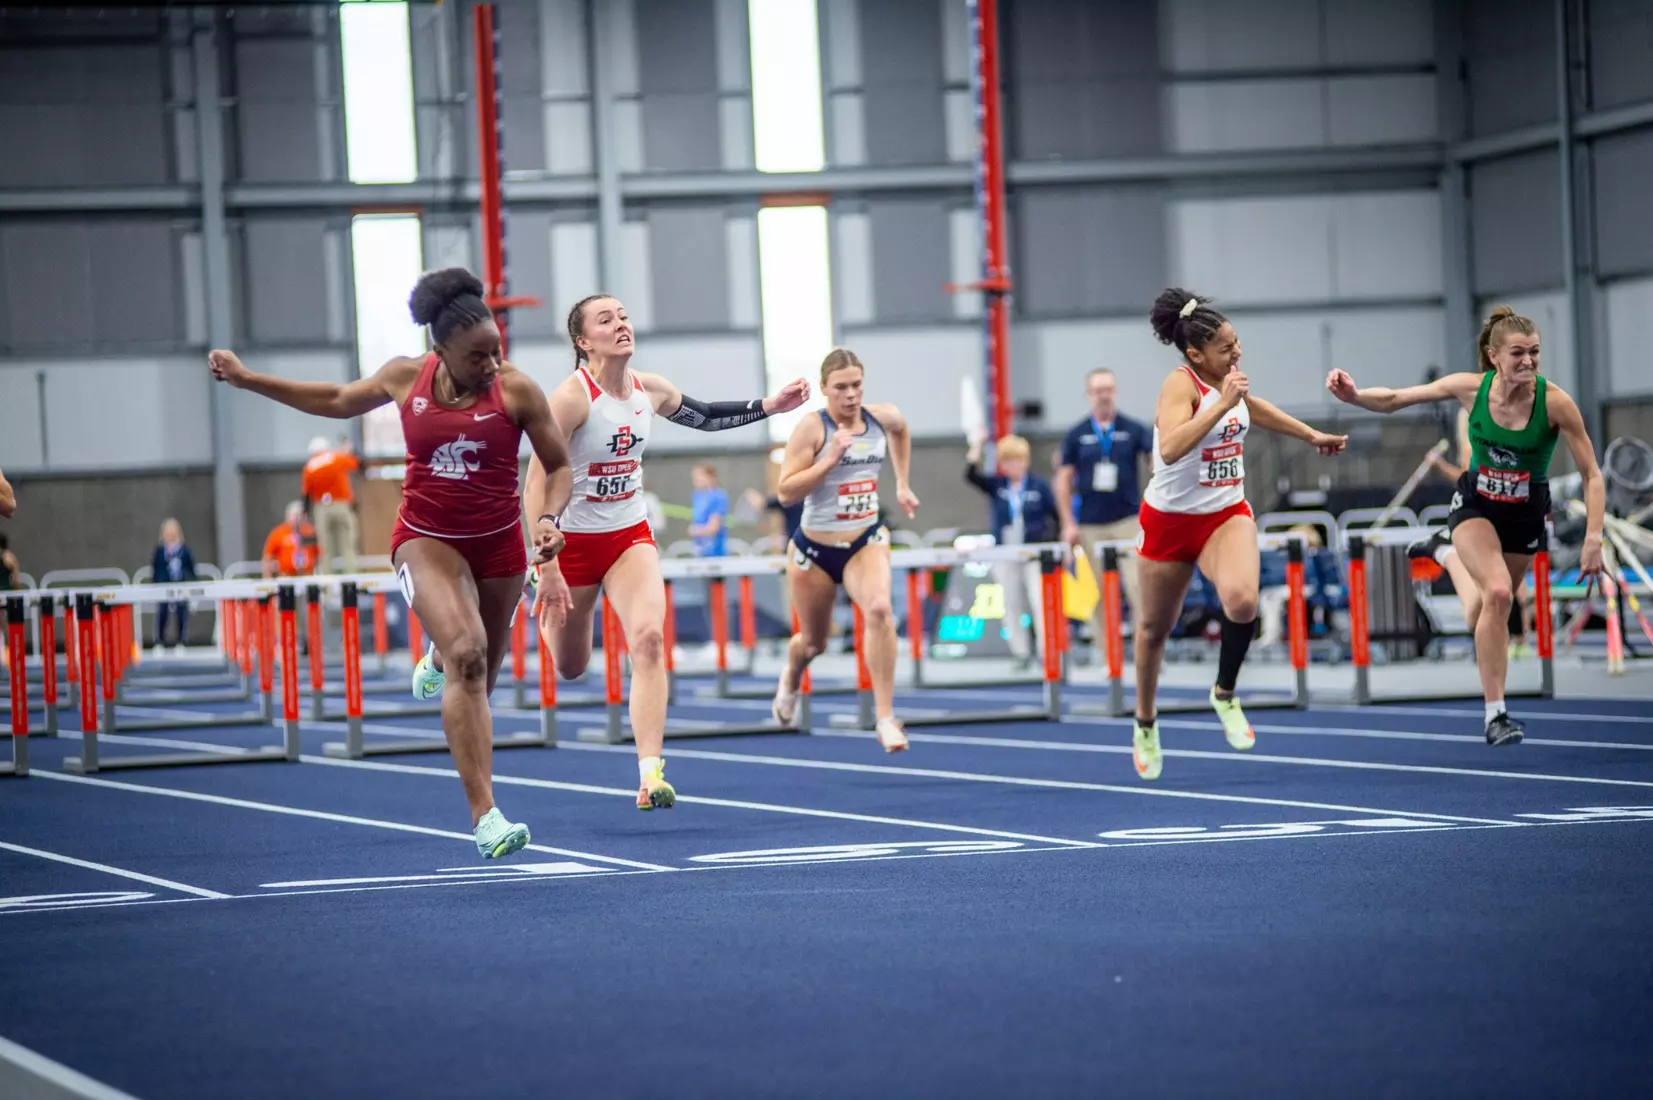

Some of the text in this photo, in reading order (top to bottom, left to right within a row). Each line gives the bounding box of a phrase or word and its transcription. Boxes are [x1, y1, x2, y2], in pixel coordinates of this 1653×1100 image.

[602, 463, 632, 474] WSU OPEN
[1208, 458, 1238, 480] 656
[596, 475, 631, 496] 657
[1487, 479, 1519, 496] 817
